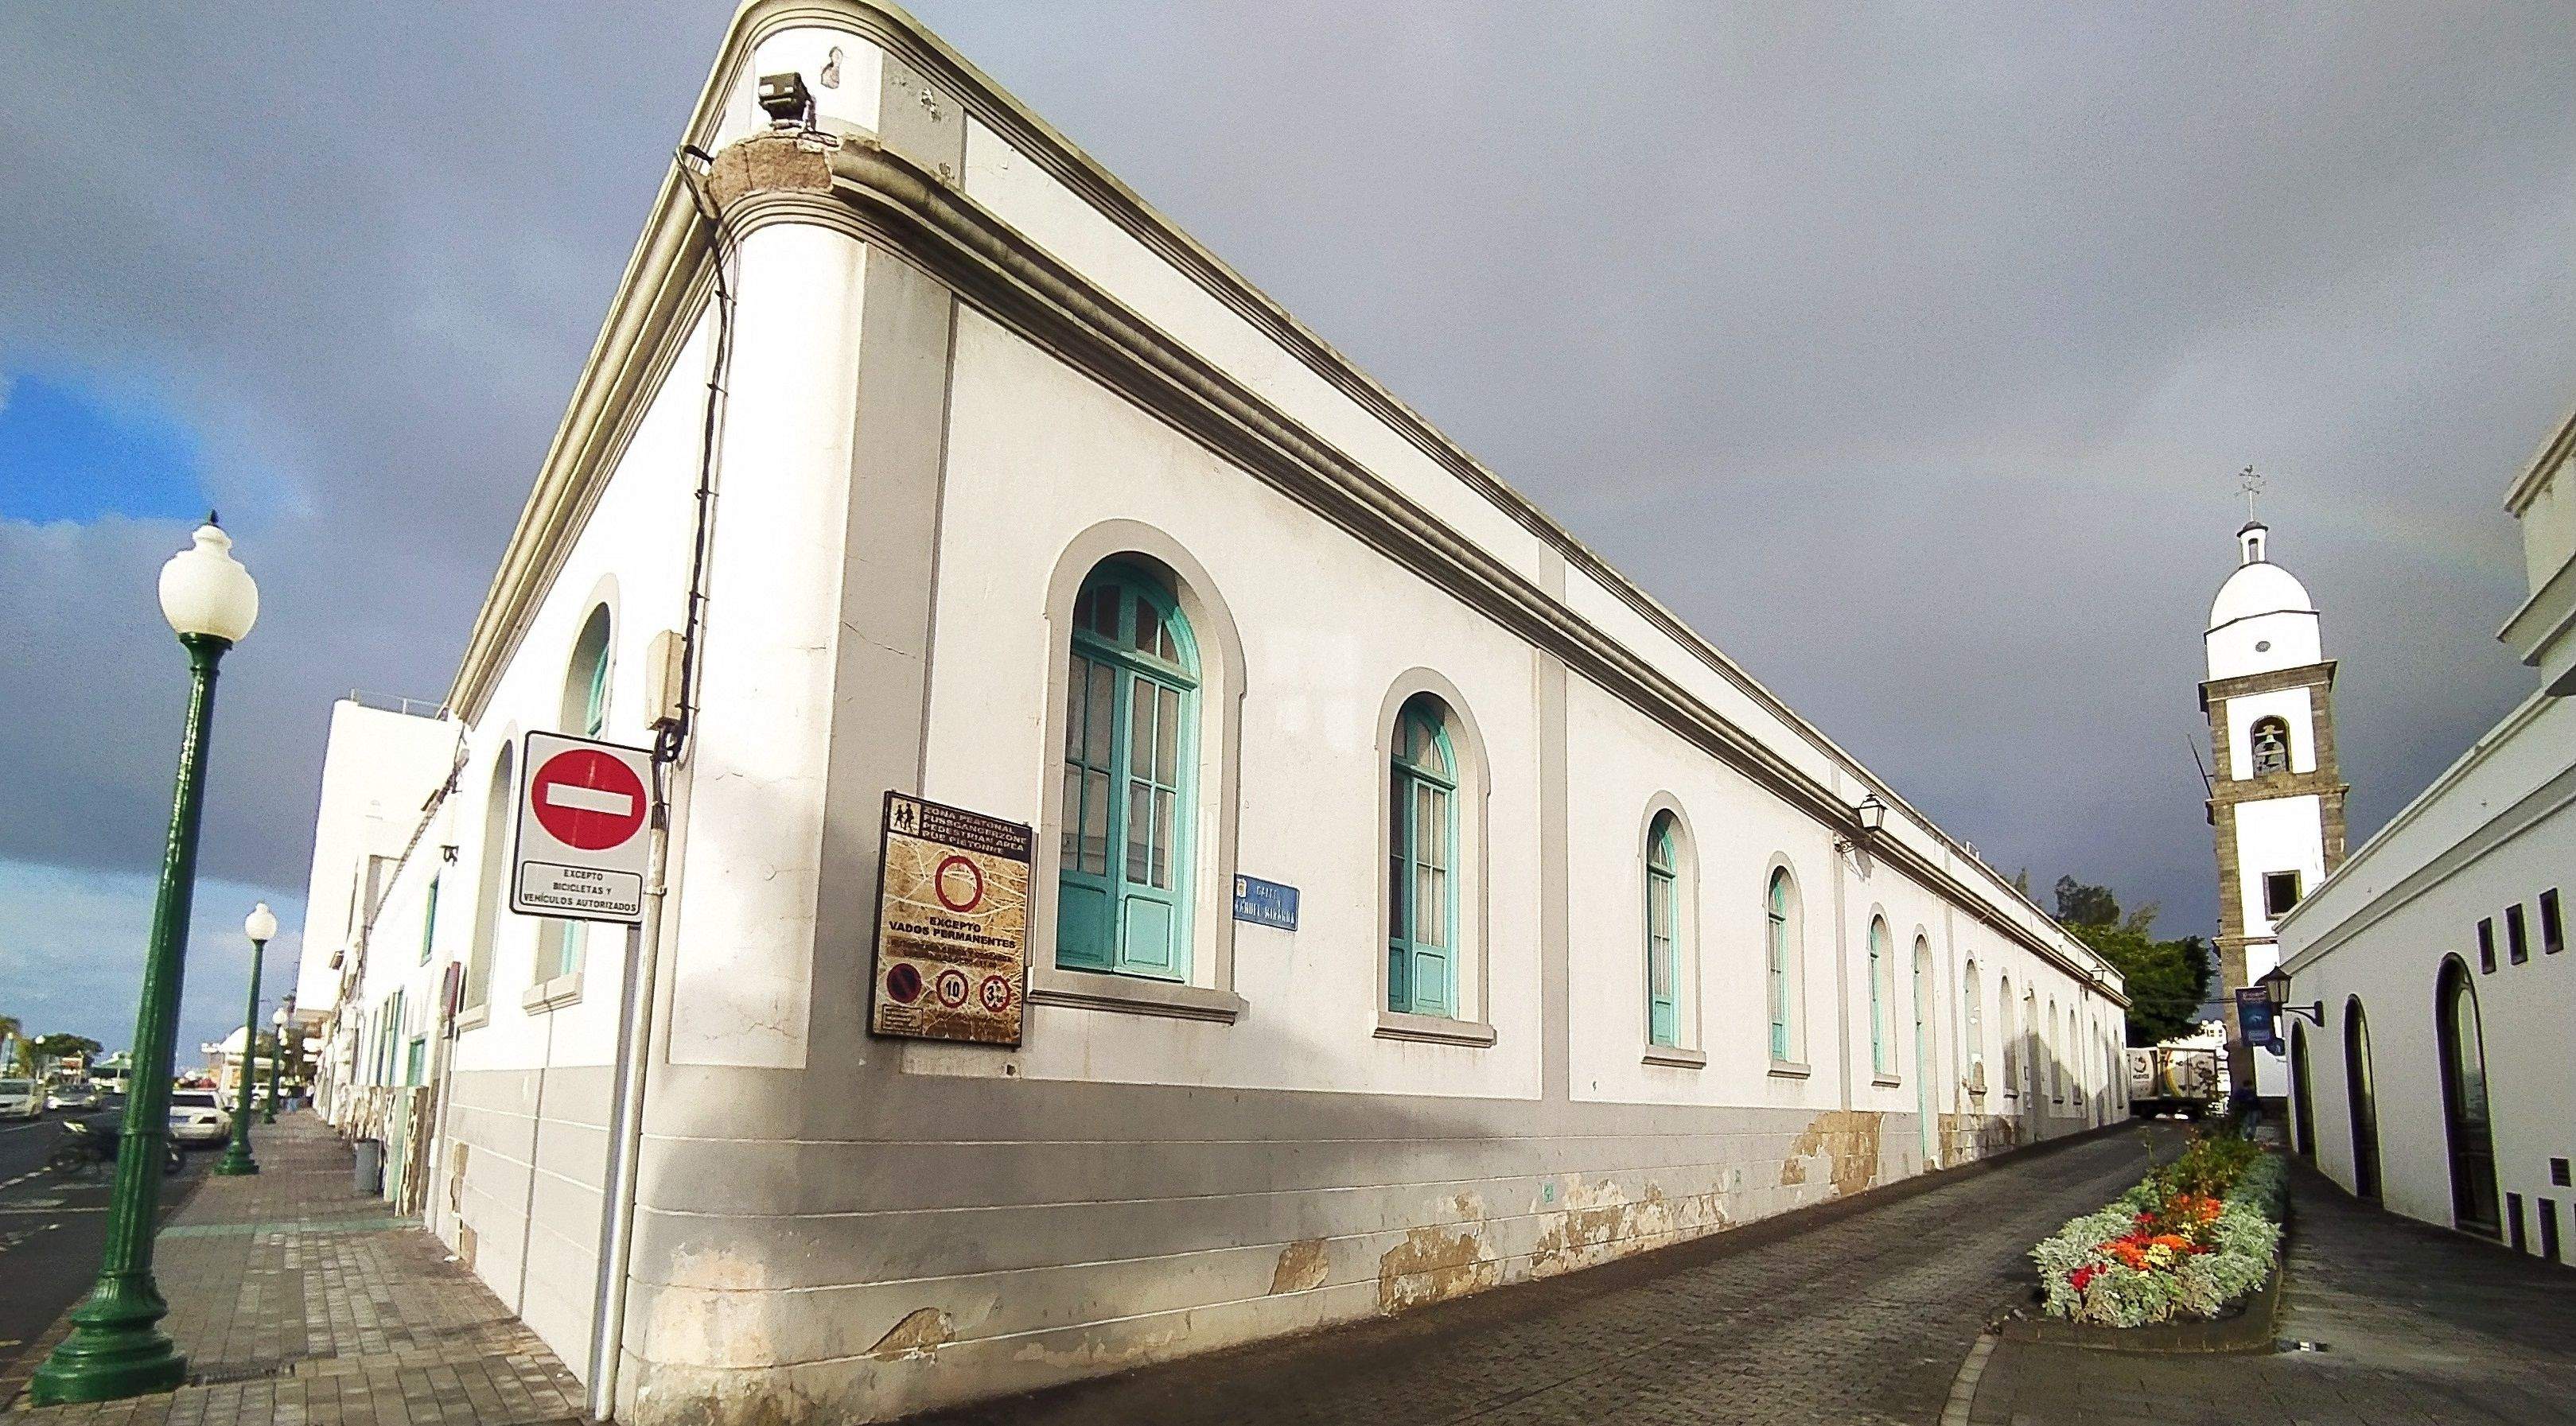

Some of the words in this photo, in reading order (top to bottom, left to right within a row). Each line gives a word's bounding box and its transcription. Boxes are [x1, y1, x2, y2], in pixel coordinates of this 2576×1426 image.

[996, 840, 1024, 852] AREA
[564, 869, 603, 880] EXCEPTO
[553, 882, 604, 895] BICICLETAS
[523, 892, 573, 906] VEHÍCULOS
[576, 899, 636, 911] AUTORIZADOS
[929, 916, 981, 932] EXCEPTO
[889, 921, 929, 935] VADOS
[933, 929, 1017, 949] PERMANENTES
[945, 981, 960, 998] 10
